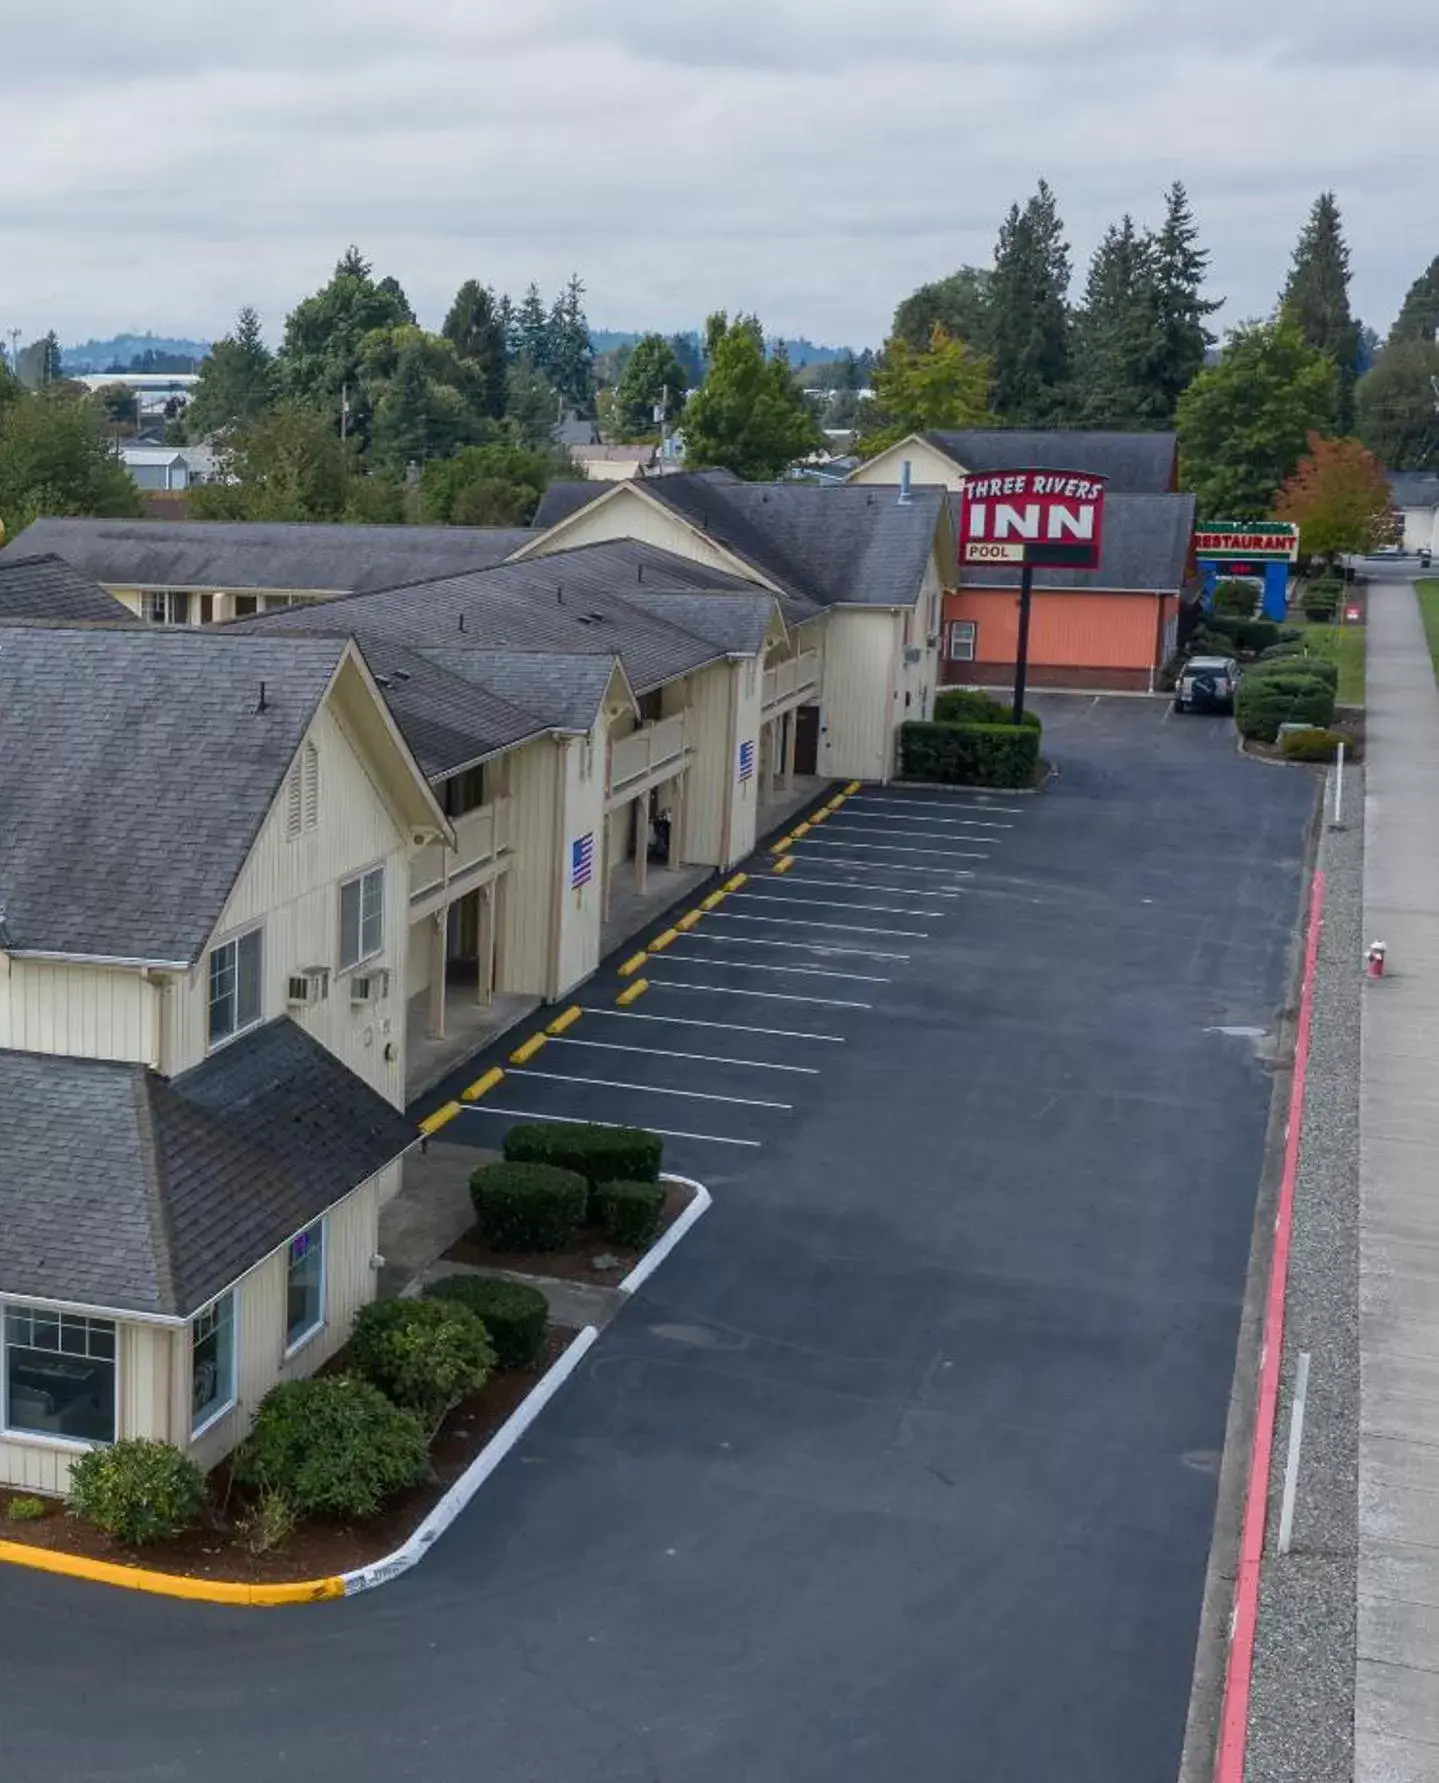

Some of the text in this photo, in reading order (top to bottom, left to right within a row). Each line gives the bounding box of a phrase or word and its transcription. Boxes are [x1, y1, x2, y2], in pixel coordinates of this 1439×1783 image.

[965, 475, 1102, 500] THREE RIVERS
[969, 503, 1095, 539] INN
[969, 545, 1009, 557] POOL
